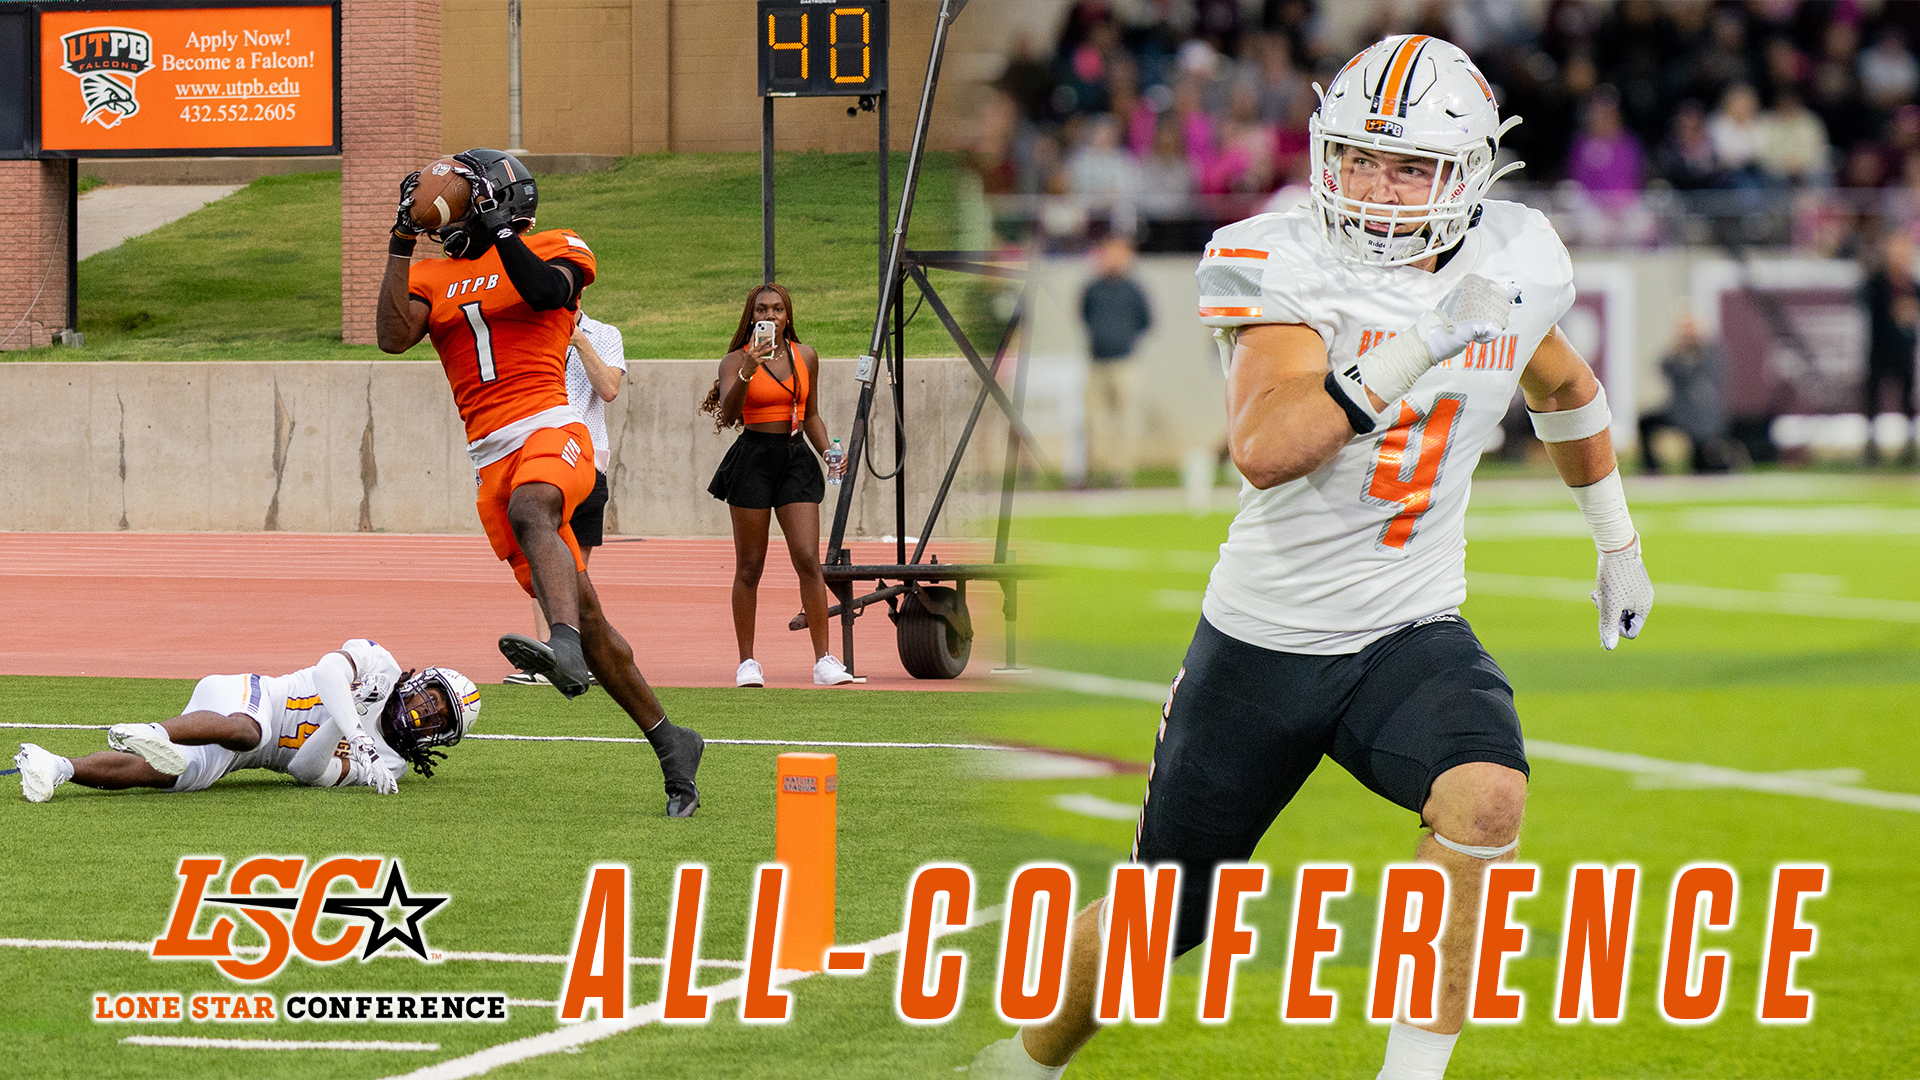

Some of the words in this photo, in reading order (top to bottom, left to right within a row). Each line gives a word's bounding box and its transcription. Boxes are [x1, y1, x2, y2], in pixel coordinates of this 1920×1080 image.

[67, 32, 148, 62] UTPB
[185, 31, 238, 52] Apply
[243, 29, 291, 47] Now!
[768, 7, 870, 84] 40
[79, 61, 138, 72] FALCONS
[162, 54, 230, 71] Become
[235, 57, 246, 70] a
[250, 51, 315, 69] Falcon!
[175, 78, 300, 99] www.utpb.edu
[180, 103, 296, 122] 432.552.2605
[1366, 120, 1402, 137] UTPB
[1368, 240, 1392, 249] Riddel
[446, 273, 500, 300] UTPB
[459, 300, 498, 384] 1
[1361, 392, 1467, 557] 4
